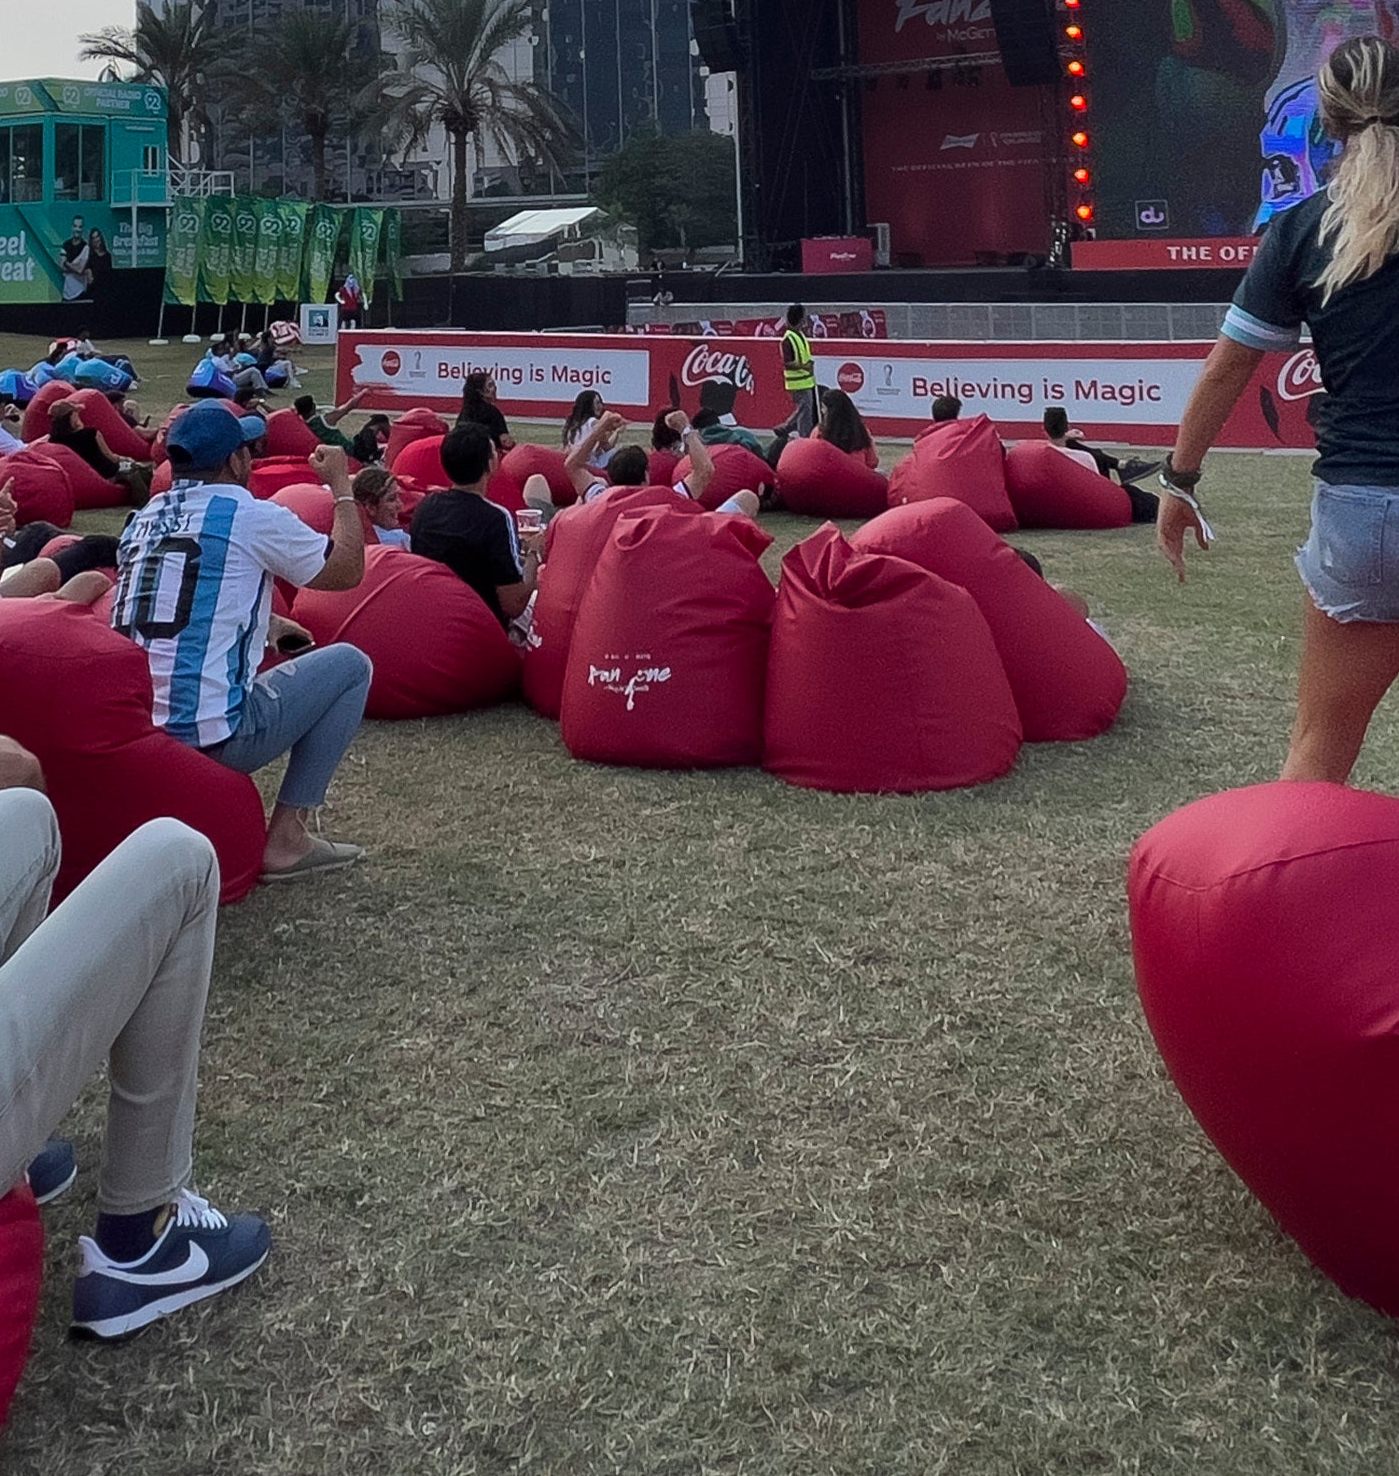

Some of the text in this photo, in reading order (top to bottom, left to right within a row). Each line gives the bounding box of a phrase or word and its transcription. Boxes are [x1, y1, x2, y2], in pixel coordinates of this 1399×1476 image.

[1168, 246, 1212, 261] THE
[438, 361, 612, 386] Believing is Magic
[912, 376, 1162, 404] Believing is Magic
[112, 537, 202, 639] 10
